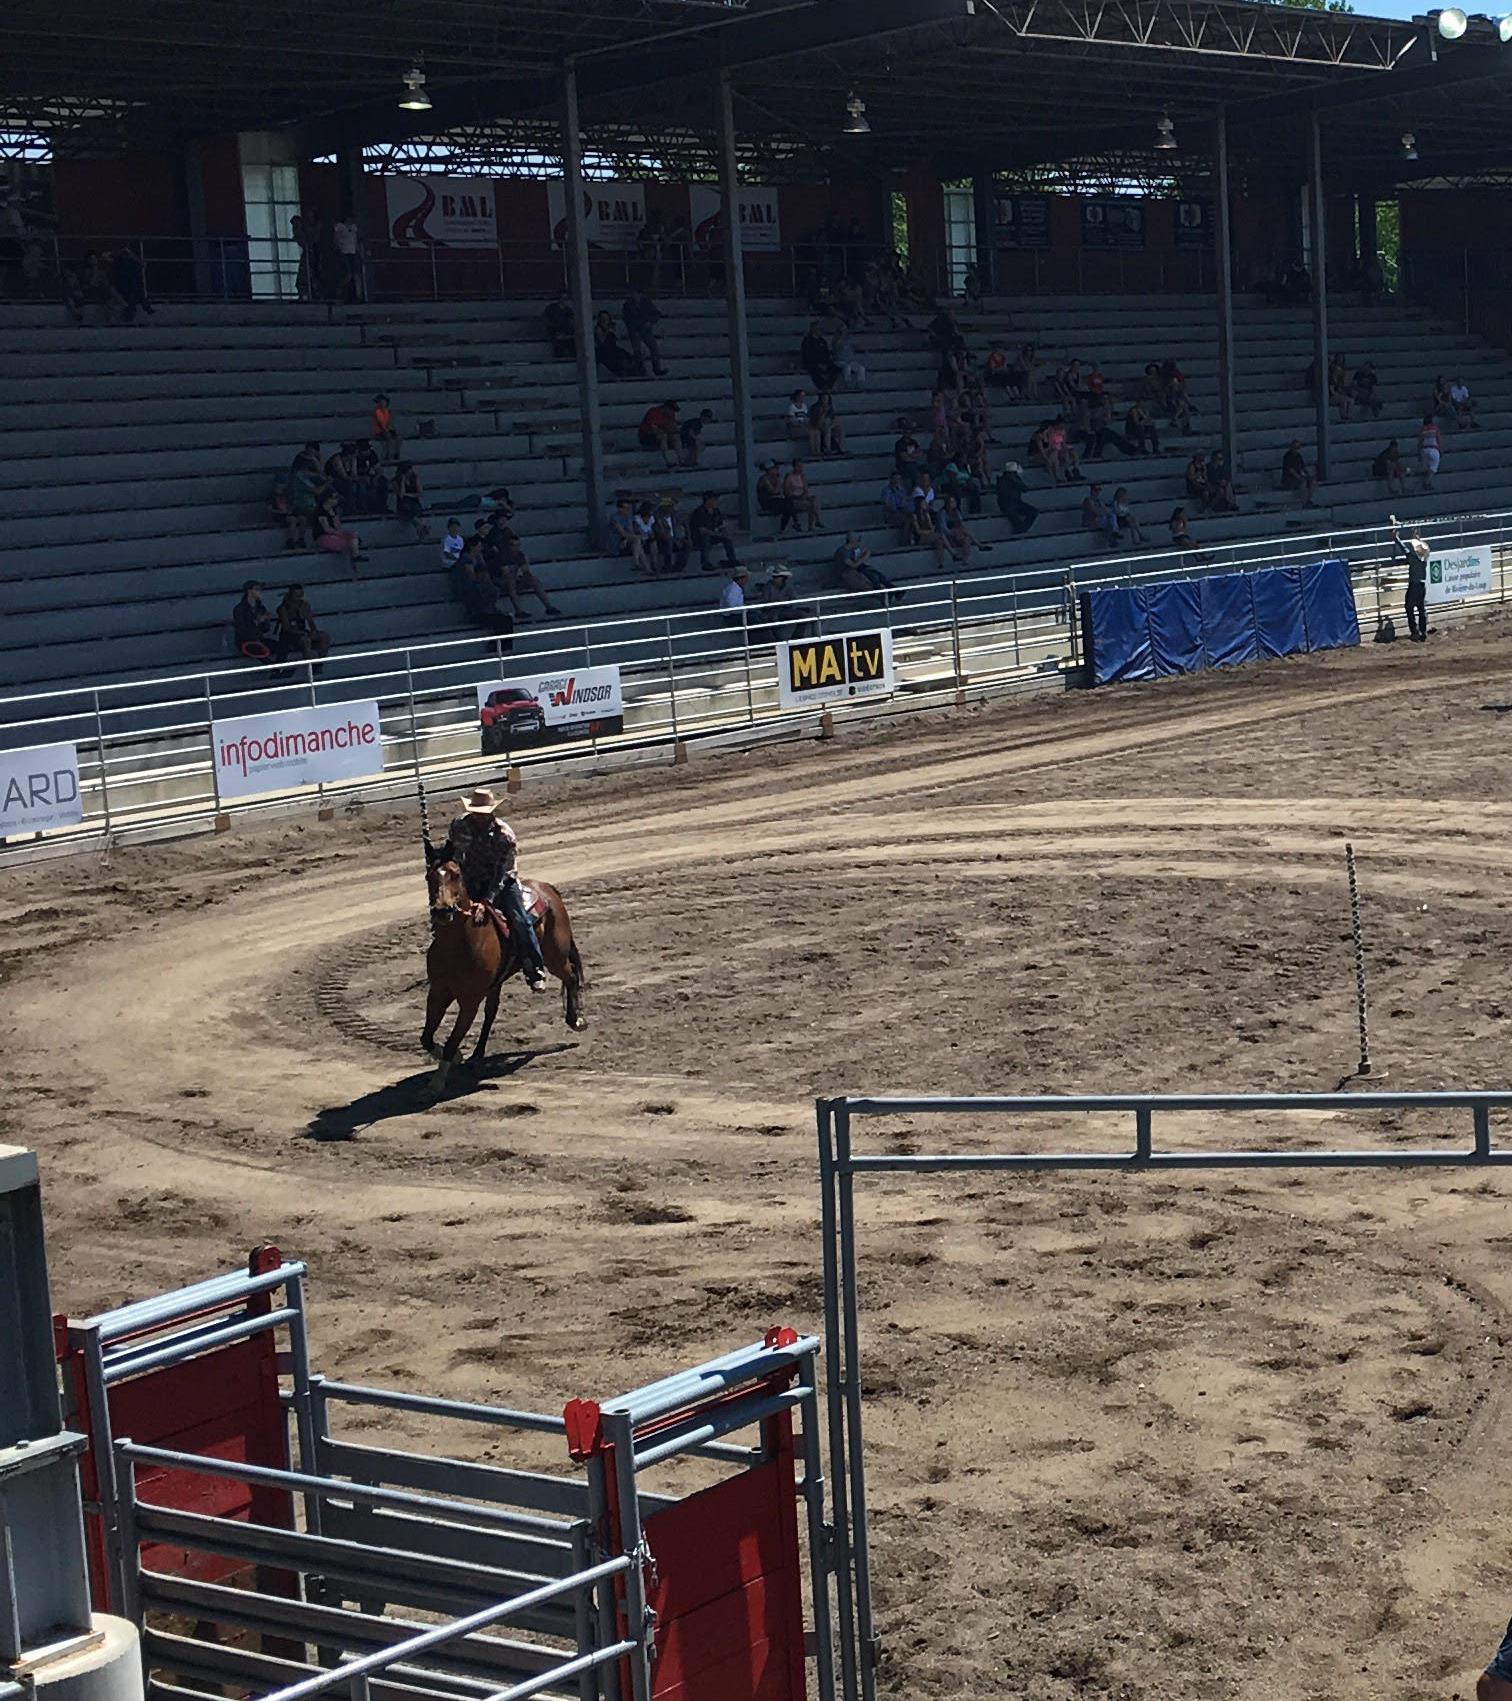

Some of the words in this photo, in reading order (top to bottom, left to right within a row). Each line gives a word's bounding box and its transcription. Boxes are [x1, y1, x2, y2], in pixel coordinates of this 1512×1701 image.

[442, 194, 493, 218] BML
[599, 200, 644, 222] BML
[792, 645, 842, 688] MA
[850, 641, 880, 677] tv
[548, 677, 612, 707] WINDSOR
[220, 720, 376, 777] infodimanche
